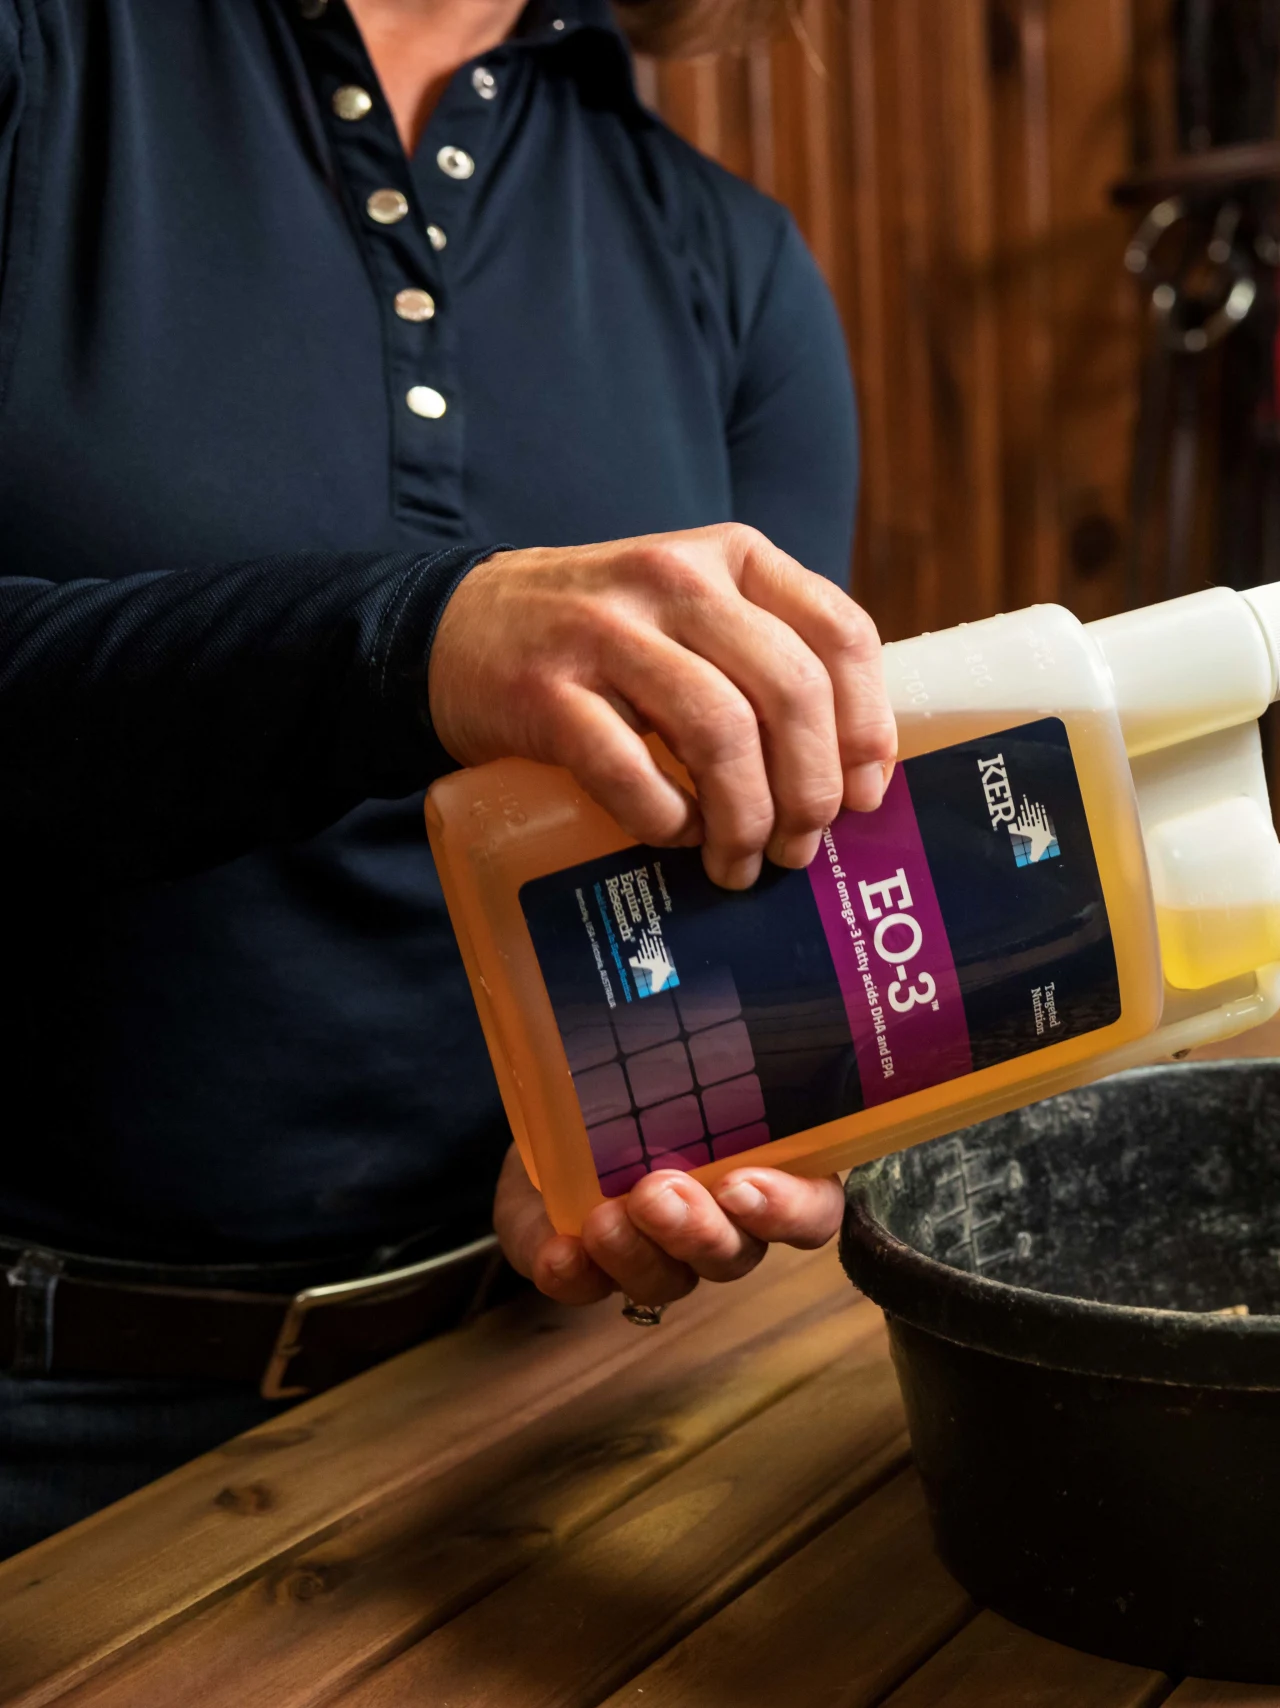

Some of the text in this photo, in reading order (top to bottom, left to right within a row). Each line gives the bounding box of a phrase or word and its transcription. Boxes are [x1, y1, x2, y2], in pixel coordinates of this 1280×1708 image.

[901, 668, 930, 705] 700
[977, 753, 1016, 829] KER
[620, 870, 642, 923] Equine
[634, 866, 662, 936] Kentucky
[822, 823, 895, 1079] ource of omega-3 fatty acids DHA and EPA
[600, 970, 616, 1009] AUSTRALIA
[1031, 986, 1046, 1035] Nutrition
[1044, 981, 1061, 1028] Targeted
